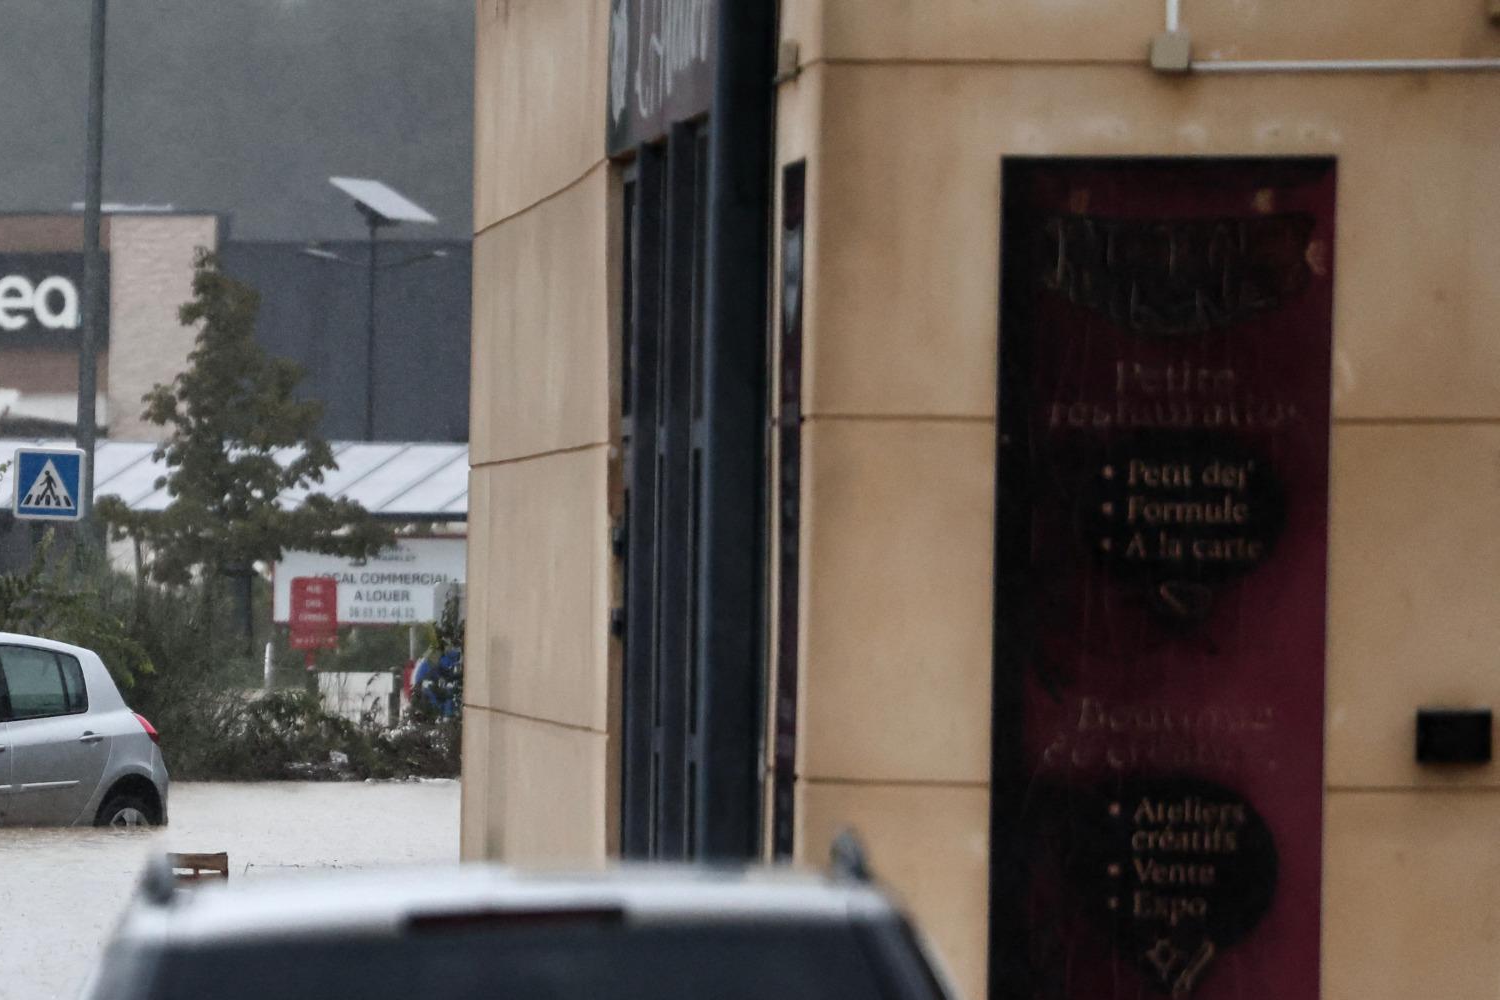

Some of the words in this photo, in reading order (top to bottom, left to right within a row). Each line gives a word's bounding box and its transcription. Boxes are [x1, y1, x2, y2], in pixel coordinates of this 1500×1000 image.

[1126, 458, 1192, 488] Petit
[1126, 494, 1250, 525] Formule
[1157, 530, 1183, 560] la
[1192, 535, 1265, 560] carte
[354, 589, 363, 601] A
[366, 589, 410, 602] LOUER
[1132, 797, 1246, 824] Ateliers
[1131, 824, 1237, 853] créatifs
[1131, 857, 1216, 885] Vente
[1132, 890, 1208, 927] Expo
